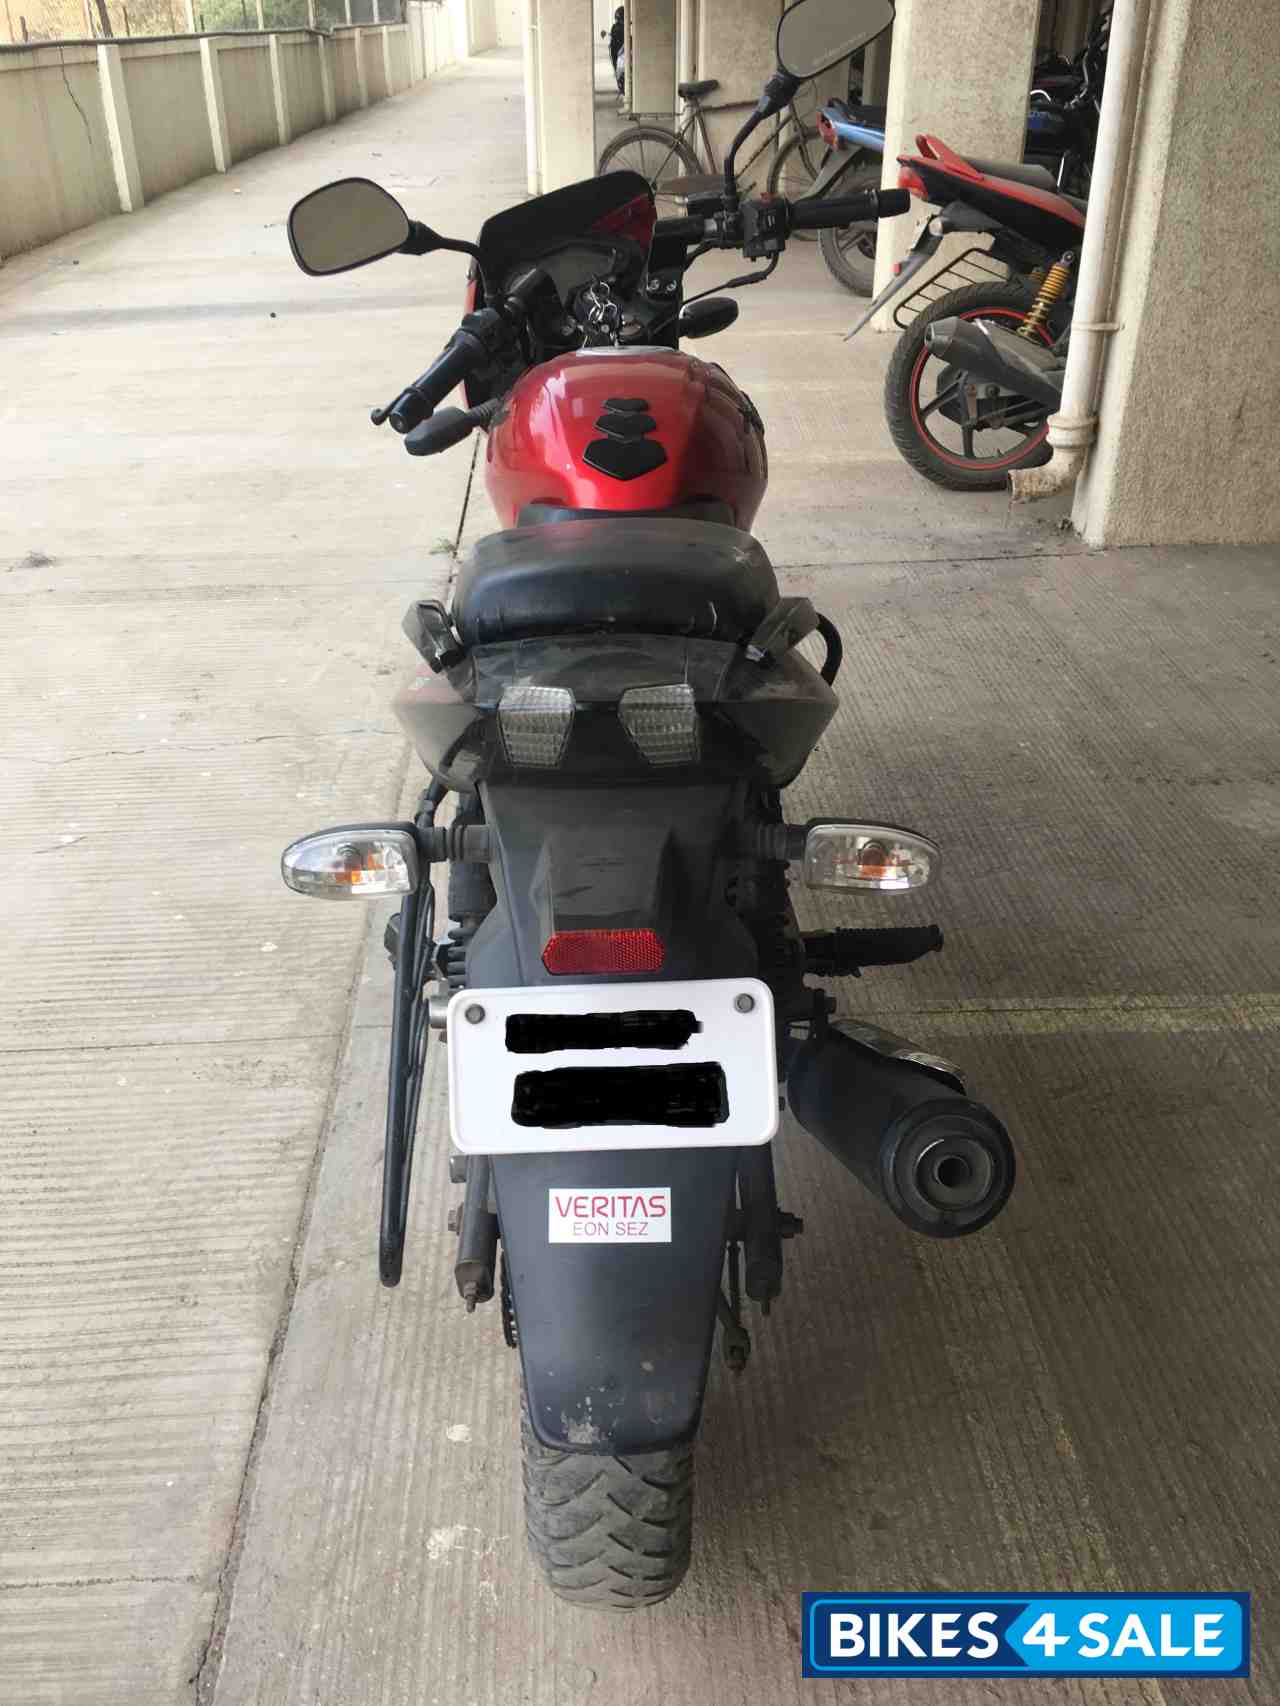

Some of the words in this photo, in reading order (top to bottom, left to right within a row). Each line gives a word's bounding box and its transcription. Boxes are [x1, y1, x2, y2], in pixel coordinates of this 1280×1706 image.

[555, 1196, 666, 1218] VERITAS
[573, 1221, 609, 1236] EON
[615, 1221, 649, 1236] SEZ
